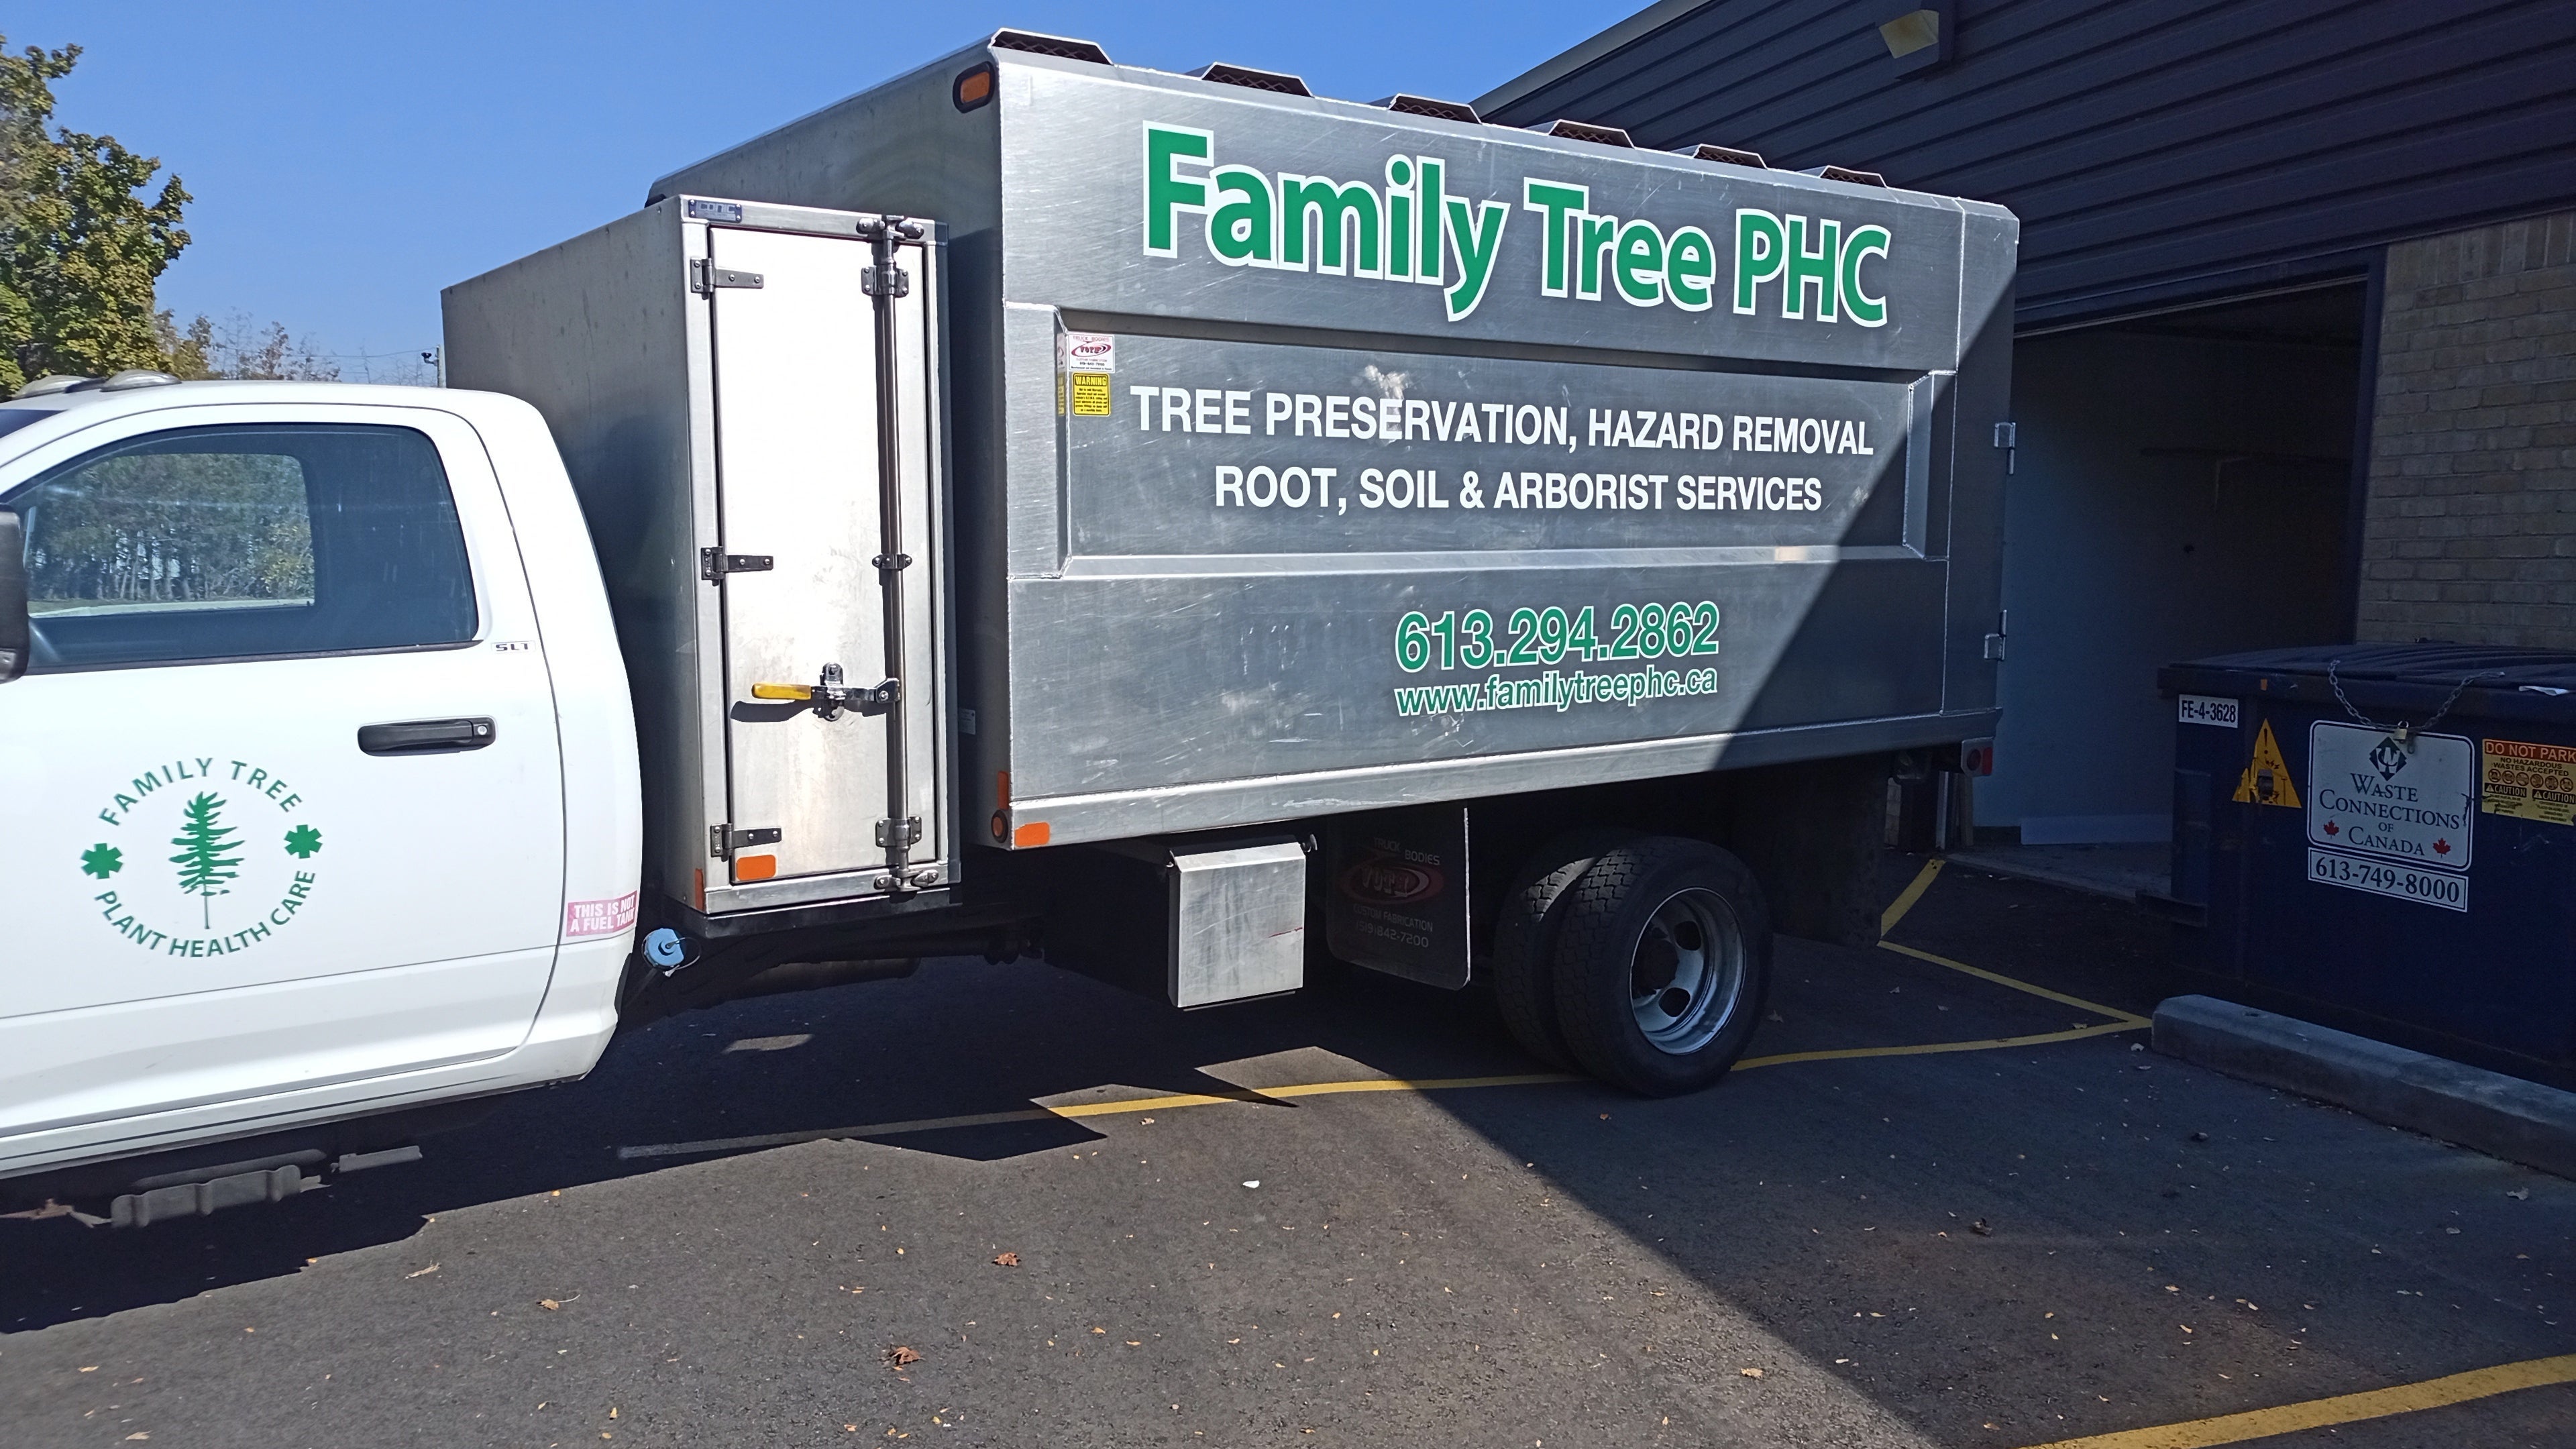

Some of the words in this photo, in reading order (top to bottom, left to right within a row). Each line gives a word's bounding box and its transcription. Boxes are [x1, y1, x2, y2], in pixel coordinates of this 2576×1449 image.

[1142, 119, 1510, 322] Family
[1523, 177, 1717, 312] Tree
[1733, 208, 1892, 327] PHC
[1075, 376, 1106, 386] WARNING
[1130, 385, 1252, 435] TREE
[1266, 392, 1576, 453] PRESERVATION,
[1588, 408, 1723, 450] HAZARD
[1733, 415, 1874, 455] REMOVAL
[1216, 466, 1347, 516] ROOT,
[1359, 468, 1449, 508] SOIL
[1459, 471, 1485, 509] &
[1494, 472, 1668, 510] ARBORIST
[1676, 474, 1822, 511] SERVICES
[496, 643, 528, 651] SLT
[1395, 600, 1719, 673] 613.294.2862
[1394, 665, 1718, 716] www.familytreephc.ca
[2182, 700, 2237, 723] FE-4-3628
[2485, 742, 2505, 755] DO
[2509, 744, 2536, 758] NOT
[2540, 747, 2576, 763] PARK
[2514, 758, 2563, 769] HAZARDOUS
[2493, 762, 2526, 771] WASTES
[2526, 766, 2569, 777] ACCEPTED
[98, 757, 213, 826] FAMILY
[231, 760, 303, 813] TREE
[2350, 773, 2419, 802] WASTE
[2494, 784, 2526, 796] CAUTION
[2542, 791, 2575, 804] CAUTION
[2319, 789, 2460, 830] CONNECTIONS
[2349, 826, 2425, 856] CANADA
[2378, 822, 2394, 833] OF
[1373, 837, 1401, 853] TRUCK
[1405, 849, 1441, 865] BODIES
[2316, 857, 2459, 903] 613-749-8000
[94, 890, 168, 950] PLANT
[168, 921, 272, 958] HEALTH
[270, 870, 316, 926] CARE
[570, 919, 580, 932] A
[583, 916, 614, 931] FUEL
[616, 908, 635, 927] TANK
[574, 903, 604, 918] THIS
[607, 902, 619, 916] IS
[621, 894, 635, 913] NOT
[1353, 904, 1382, 920] CUSTOM
[1383, 911, 1434, 932] FABRICATION
